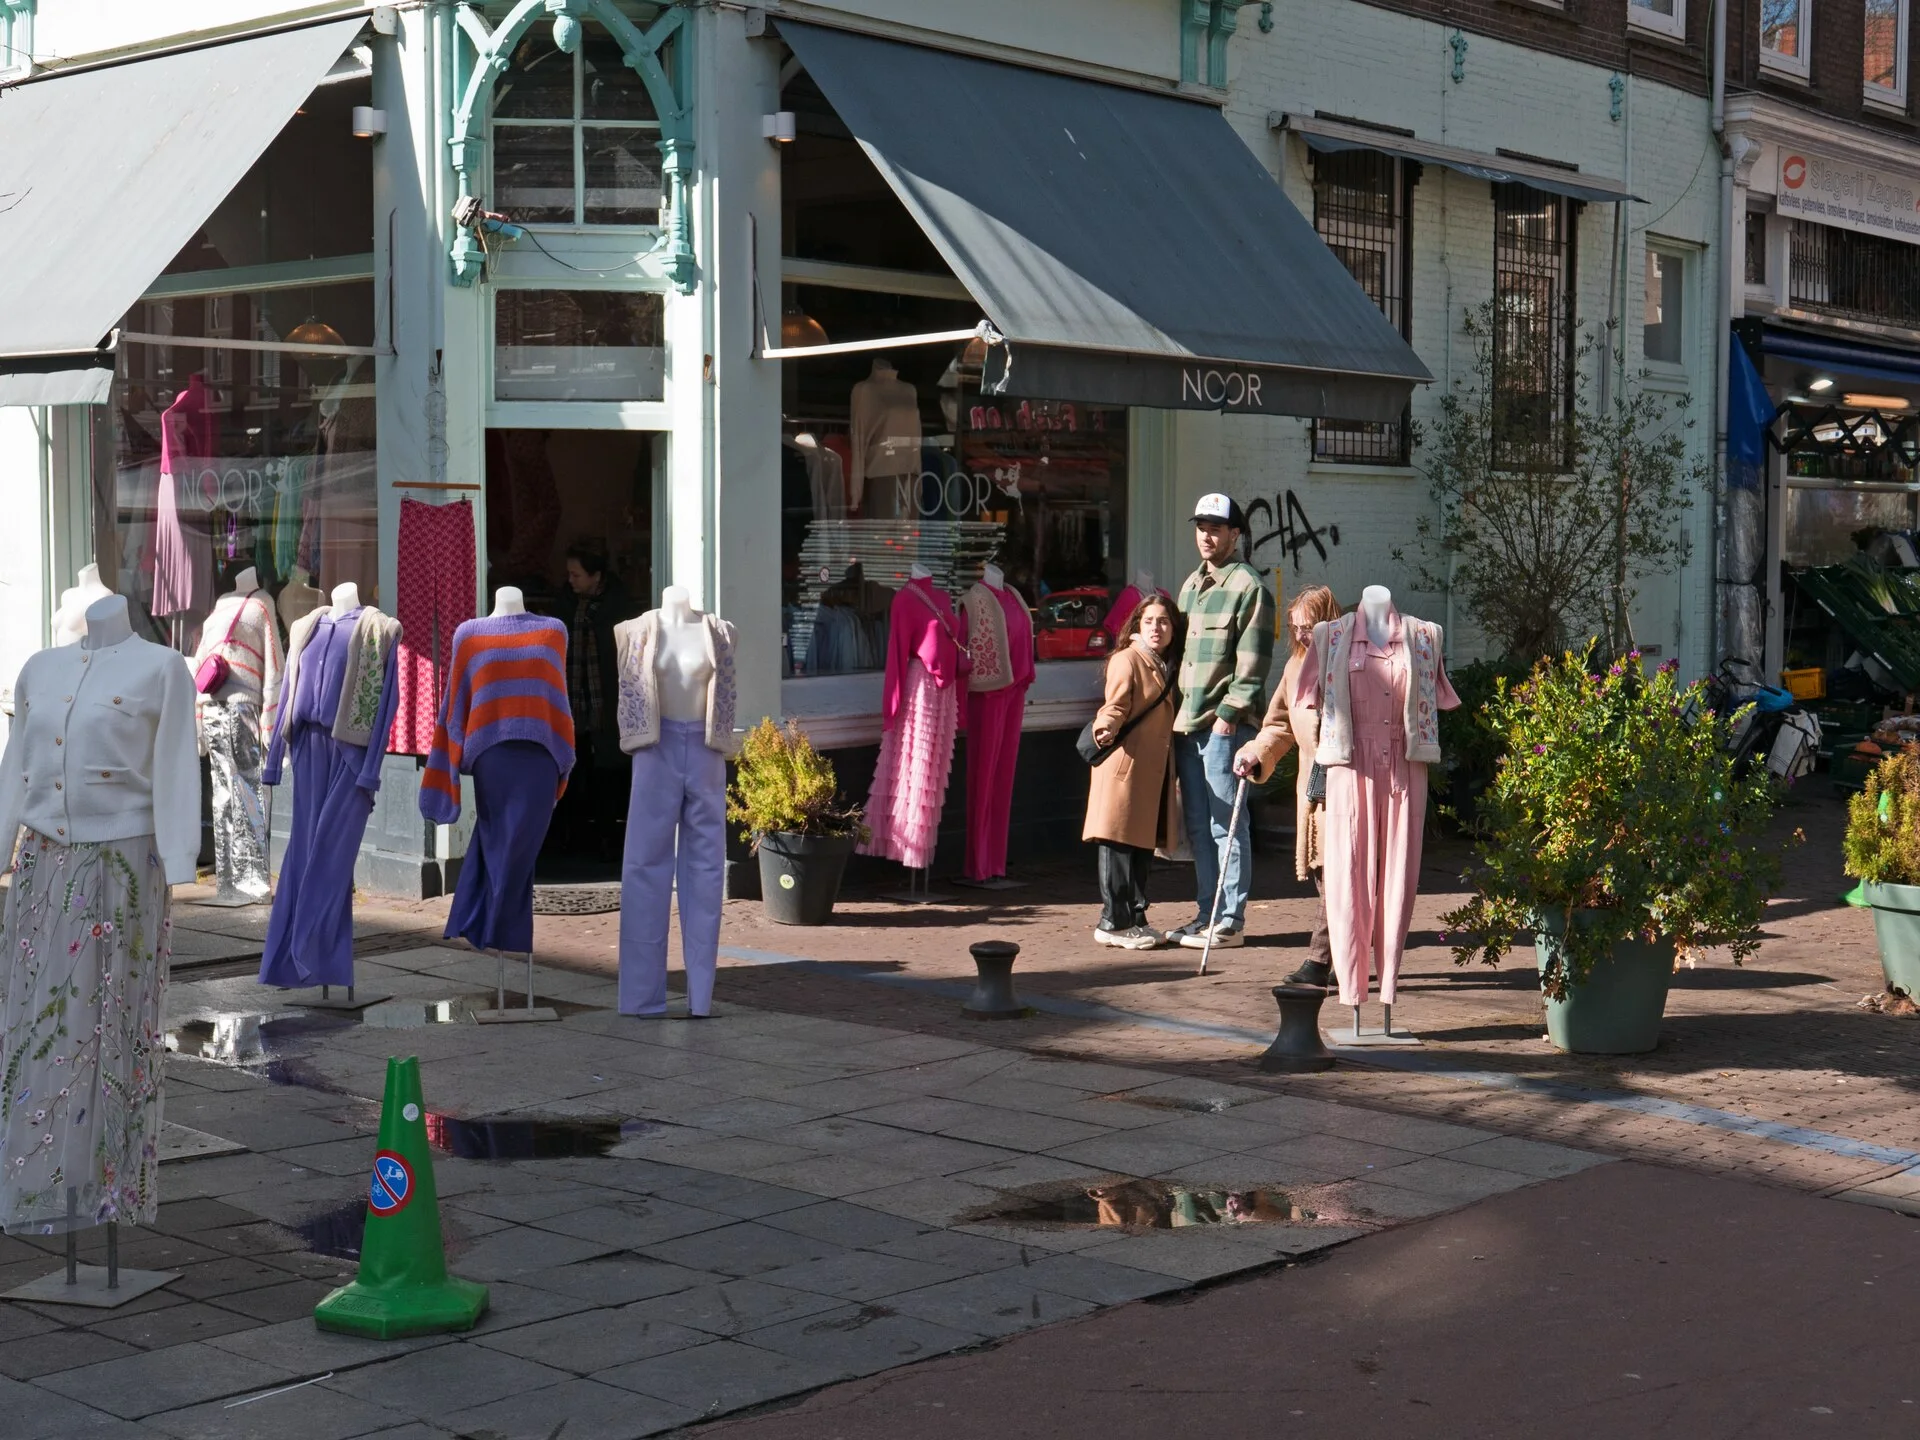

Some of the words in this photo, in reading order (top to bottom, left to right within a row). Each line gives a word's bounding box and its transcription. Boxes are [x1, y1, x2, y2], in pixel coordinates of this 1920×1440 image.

[1810, 159, 1863, 206] Slagerij
[1866, 174, 1914, 212] Zagora
[1182, 368, 1263, 406] NOOR
[182, 468, 263, 513] NOOR
[895, 471, 992, 516] NOOR
